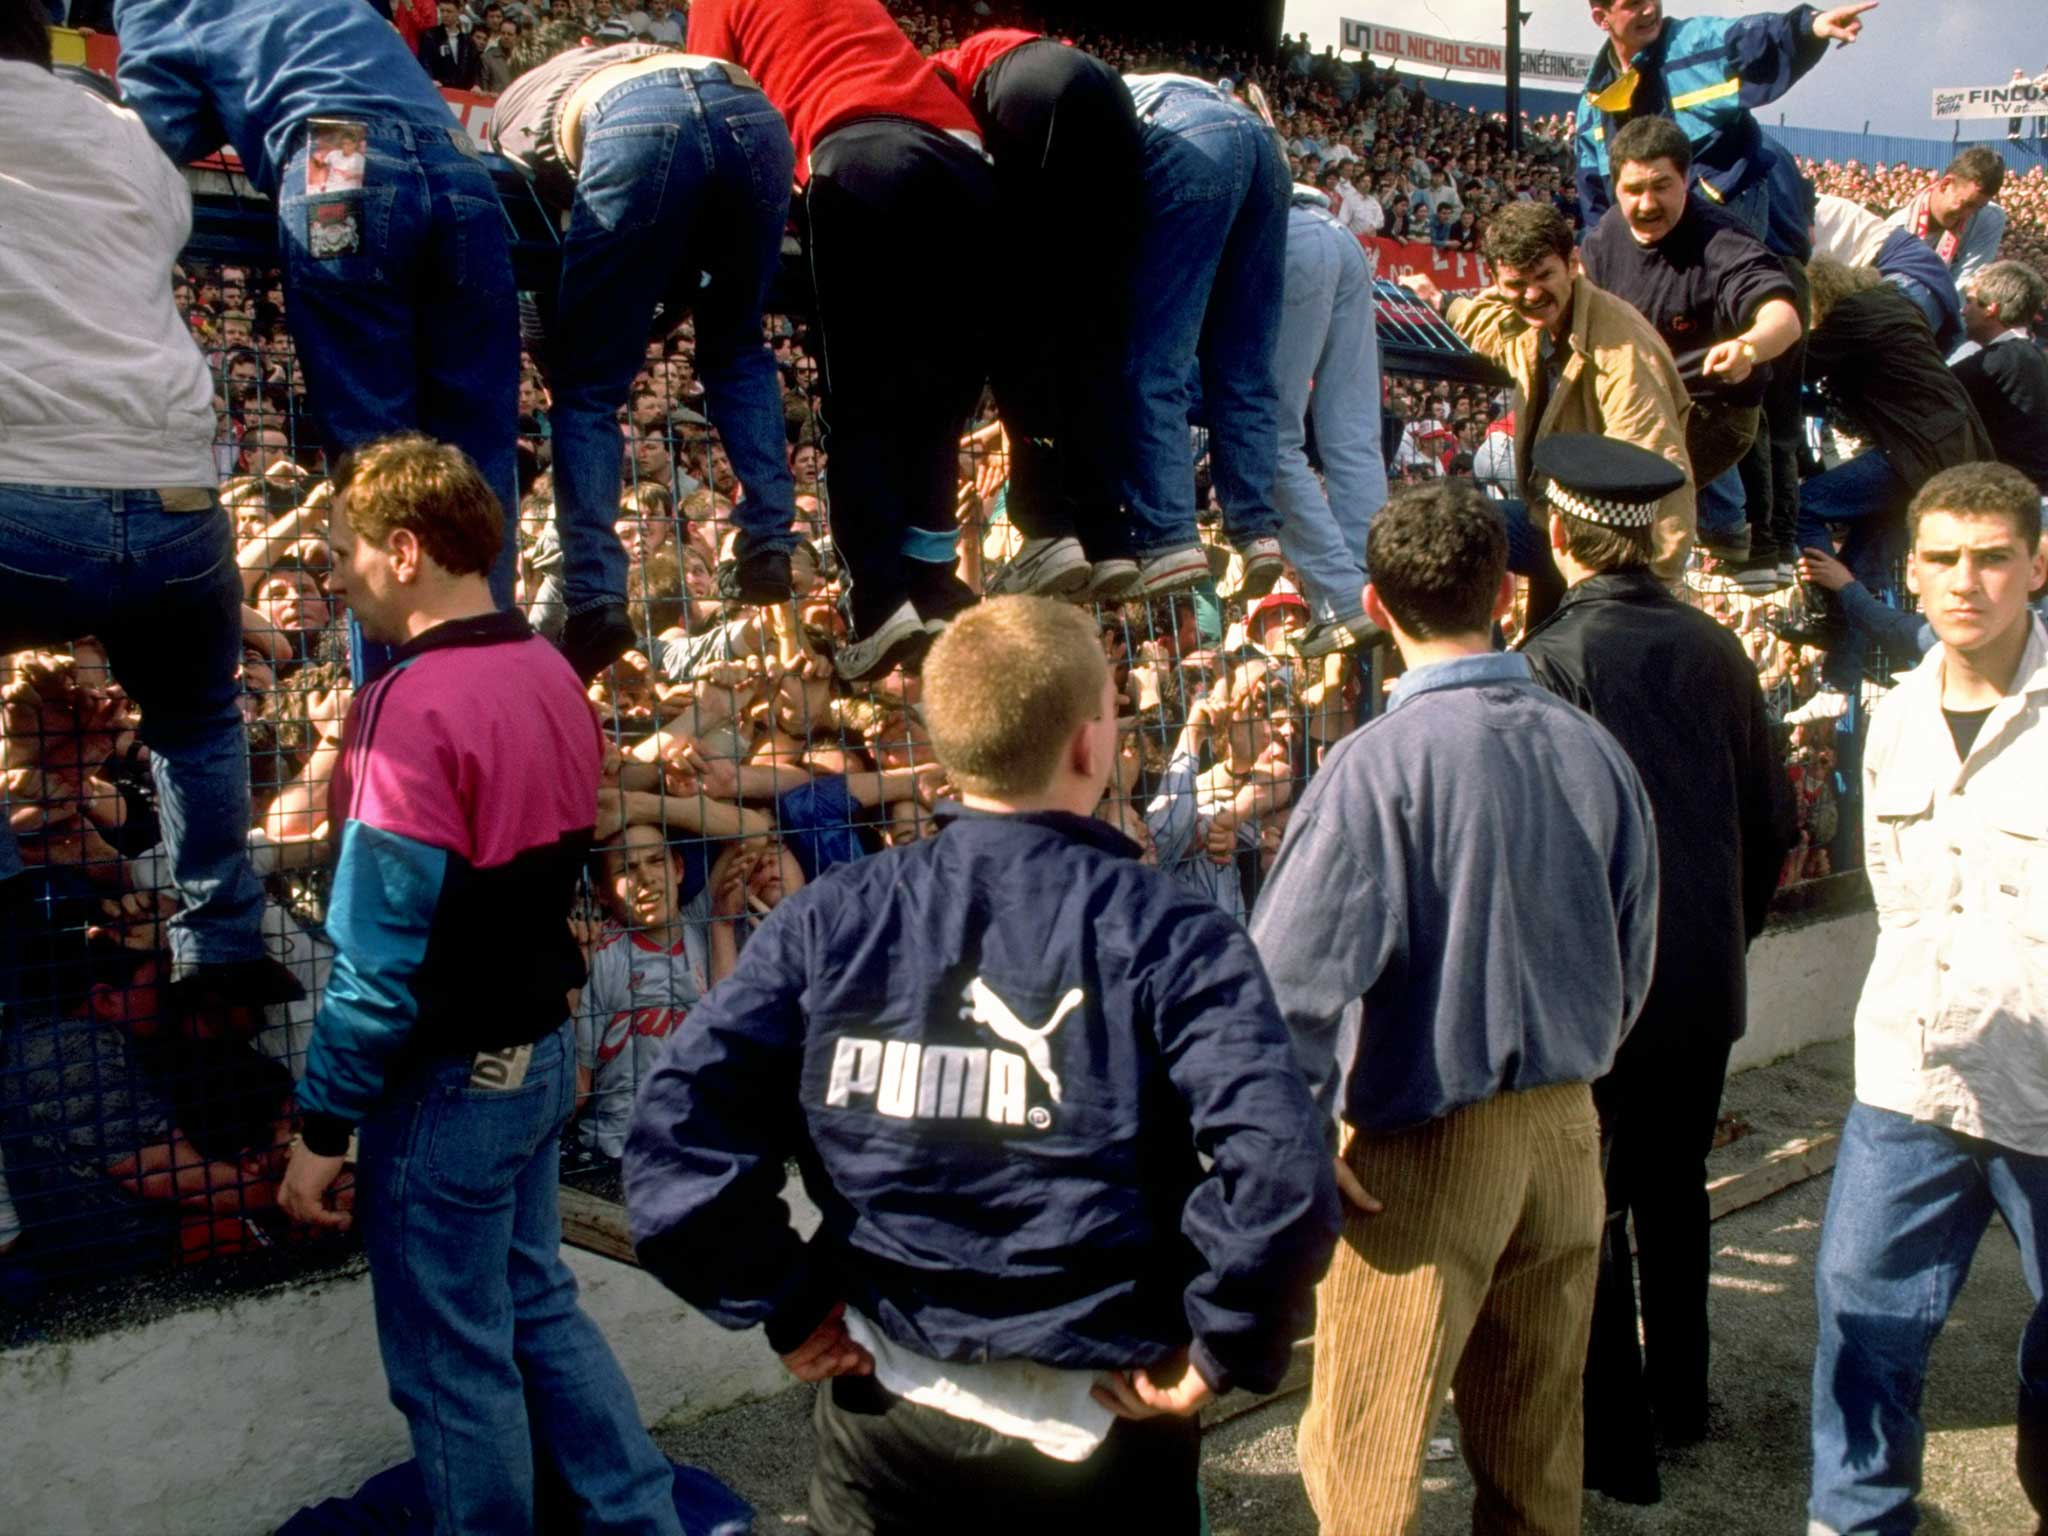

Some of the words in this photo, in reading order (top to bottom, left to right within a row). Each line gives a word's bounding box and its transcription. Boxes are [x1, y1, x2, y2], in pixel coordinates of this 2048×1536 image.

[1374, 29, 1404, 56] LOL
[1407, 36, 1502, 70] NICHOLSON
[1992, 103, 2011, 114] TV
[826, 1036, 1026, 1125] PUMA
